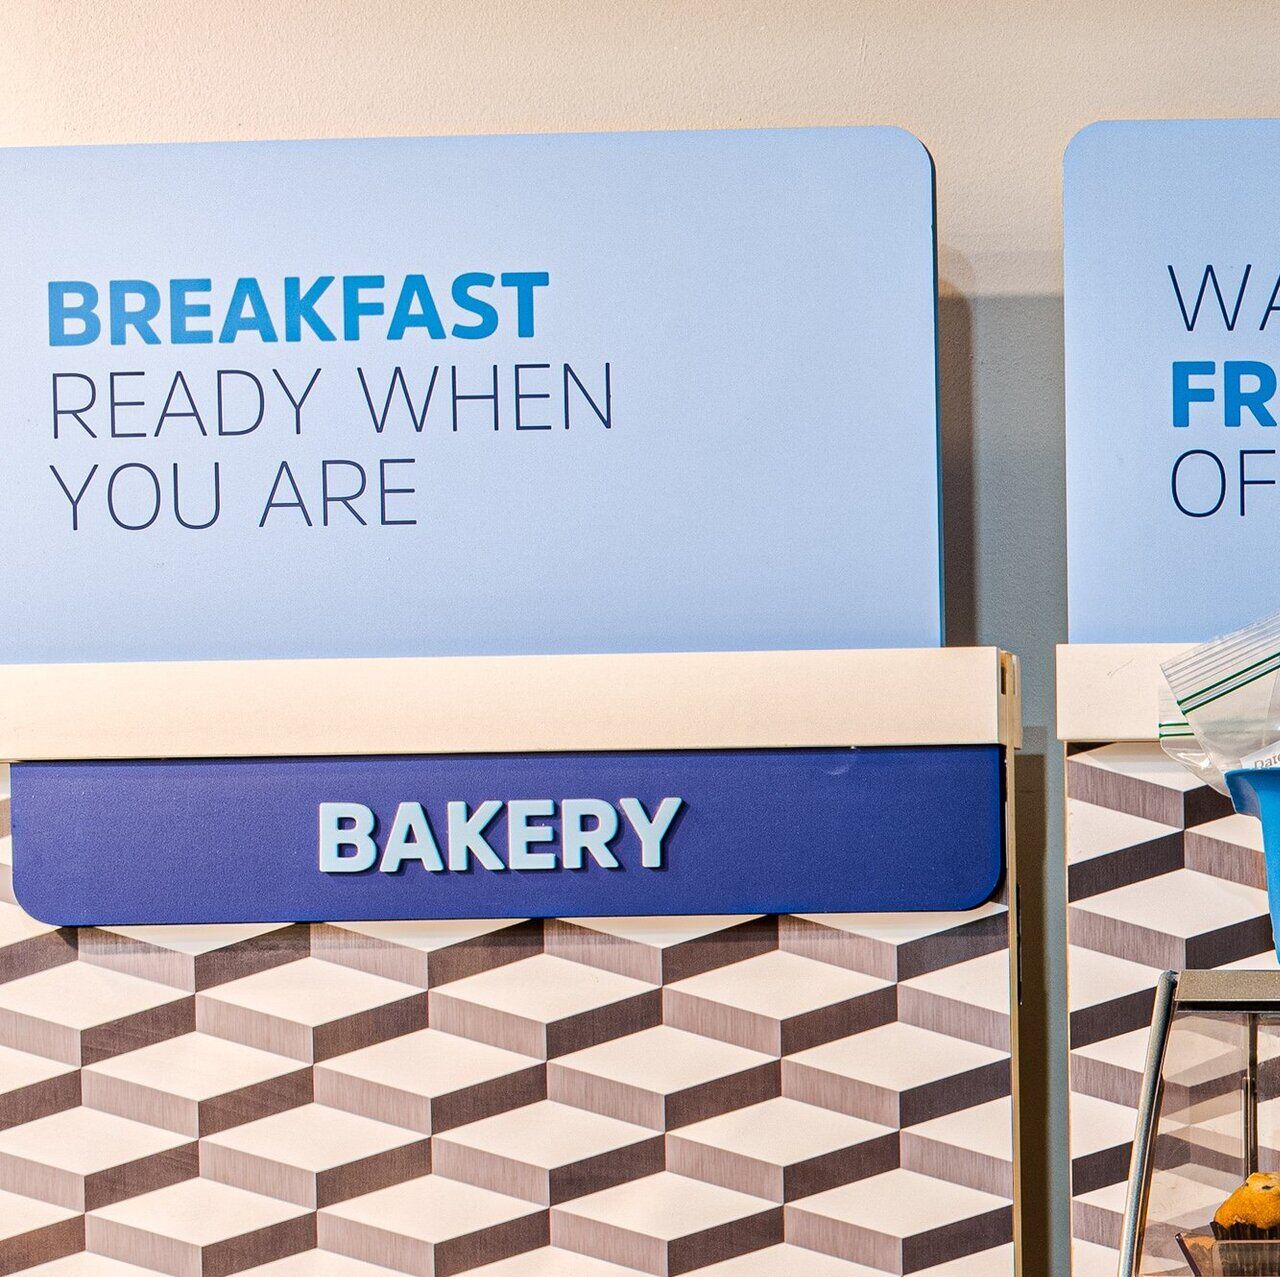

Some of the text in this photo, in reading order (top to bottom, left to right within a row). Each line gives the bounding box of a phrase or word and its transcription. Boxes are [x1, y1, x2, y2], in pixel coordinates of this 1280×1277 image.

[46, 271, 550, 347] BREAKFAST
[51, 361, 614, 439] READY WHEN
[48, 457, 417, 532] YOU ARE
[1170, 449, 1276, 519] OF
[318, 796, 684, 874] BAKERY
